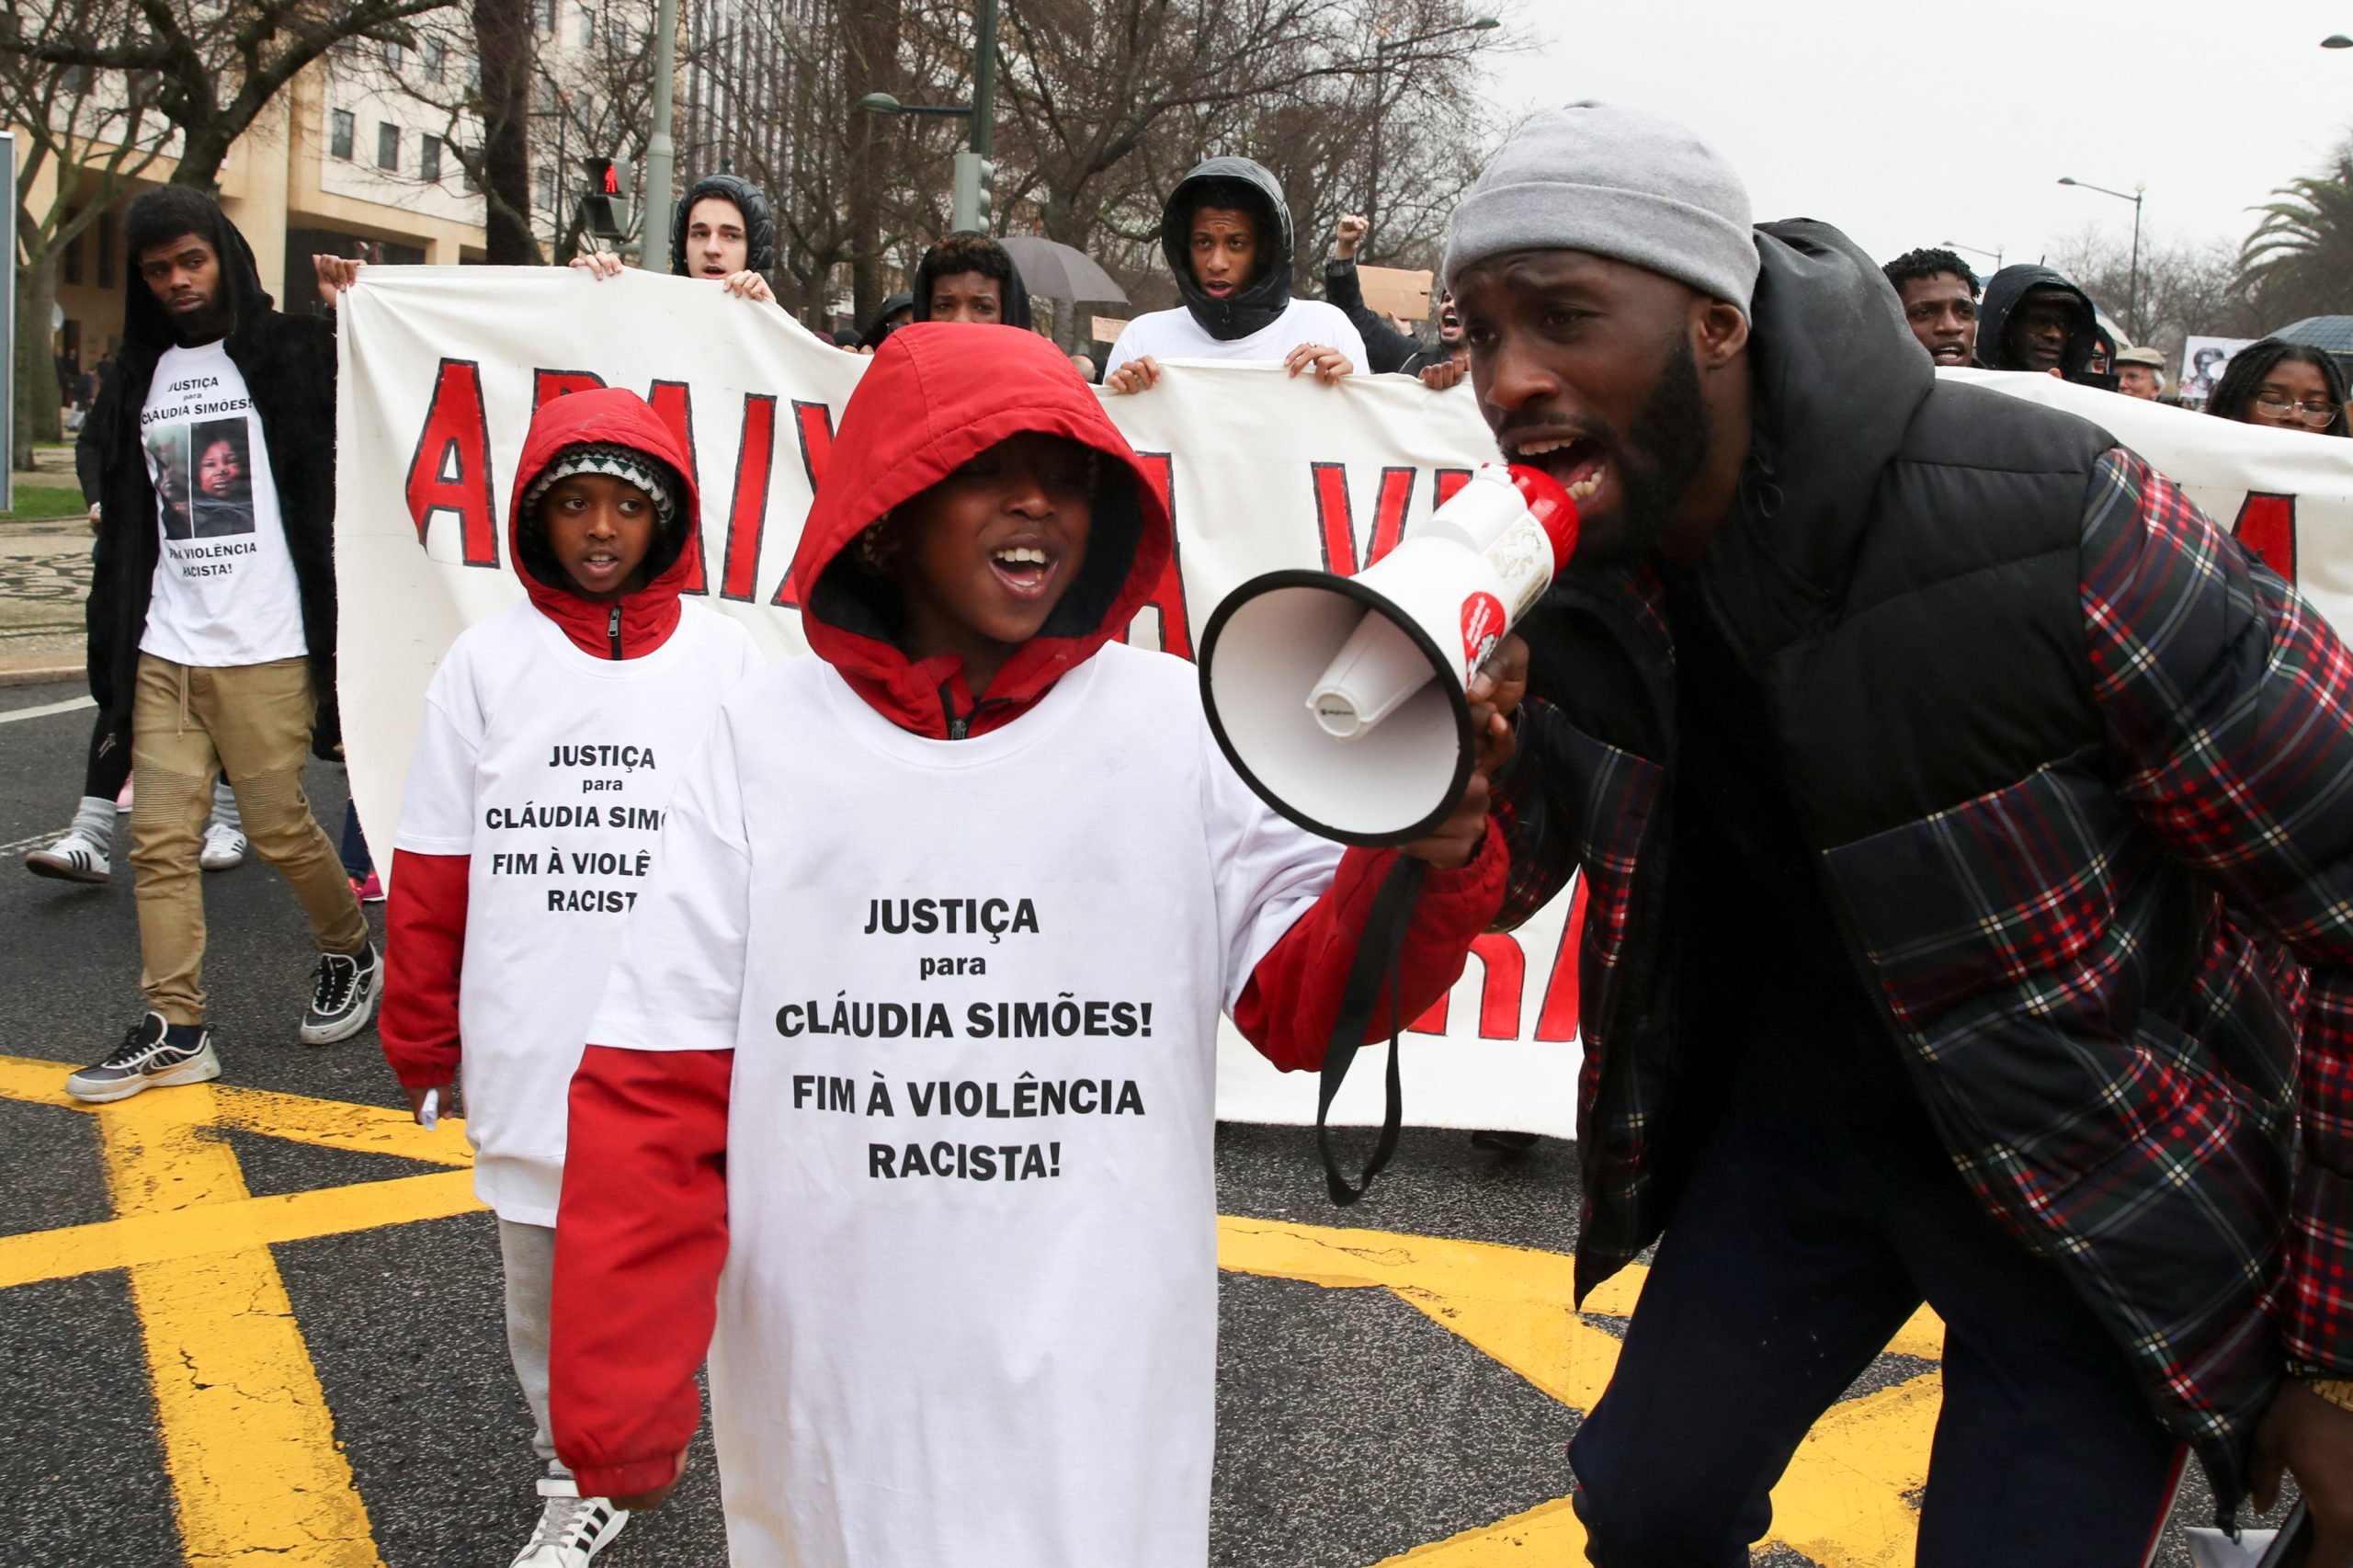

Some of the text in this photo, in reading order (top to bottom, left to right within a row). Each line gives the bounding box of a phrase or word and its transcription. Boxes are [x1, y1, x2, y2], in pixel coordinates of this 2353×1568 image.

[167, 376, 220, 392] JUSTIÇA
[183, 392, 203, 402] para
[141, 397, 253, 426] CLÁUDIA SIMÕES!
[184, 541, 257, 560] VIOLÊNCIA
[549, 744, 656, 773] JUSTIÇA
[582, 779, 624, 794] para
[485, 801, 668, 831] CLÁUDIA SIM
[492, 853, 538, 875] FIM
[547, 846, 564, 874] À
[864, 898, 1040, 945] JUSTIÇA
[919, 956, 986, 981] para
[775, 989, 1153, 1039] CLÁUDIA SIMÕES!
[792, 1070, 1145, 1119] FIM À VIOLÊNCIA
[869, 1141, 1061, 1182] RACISTA!
